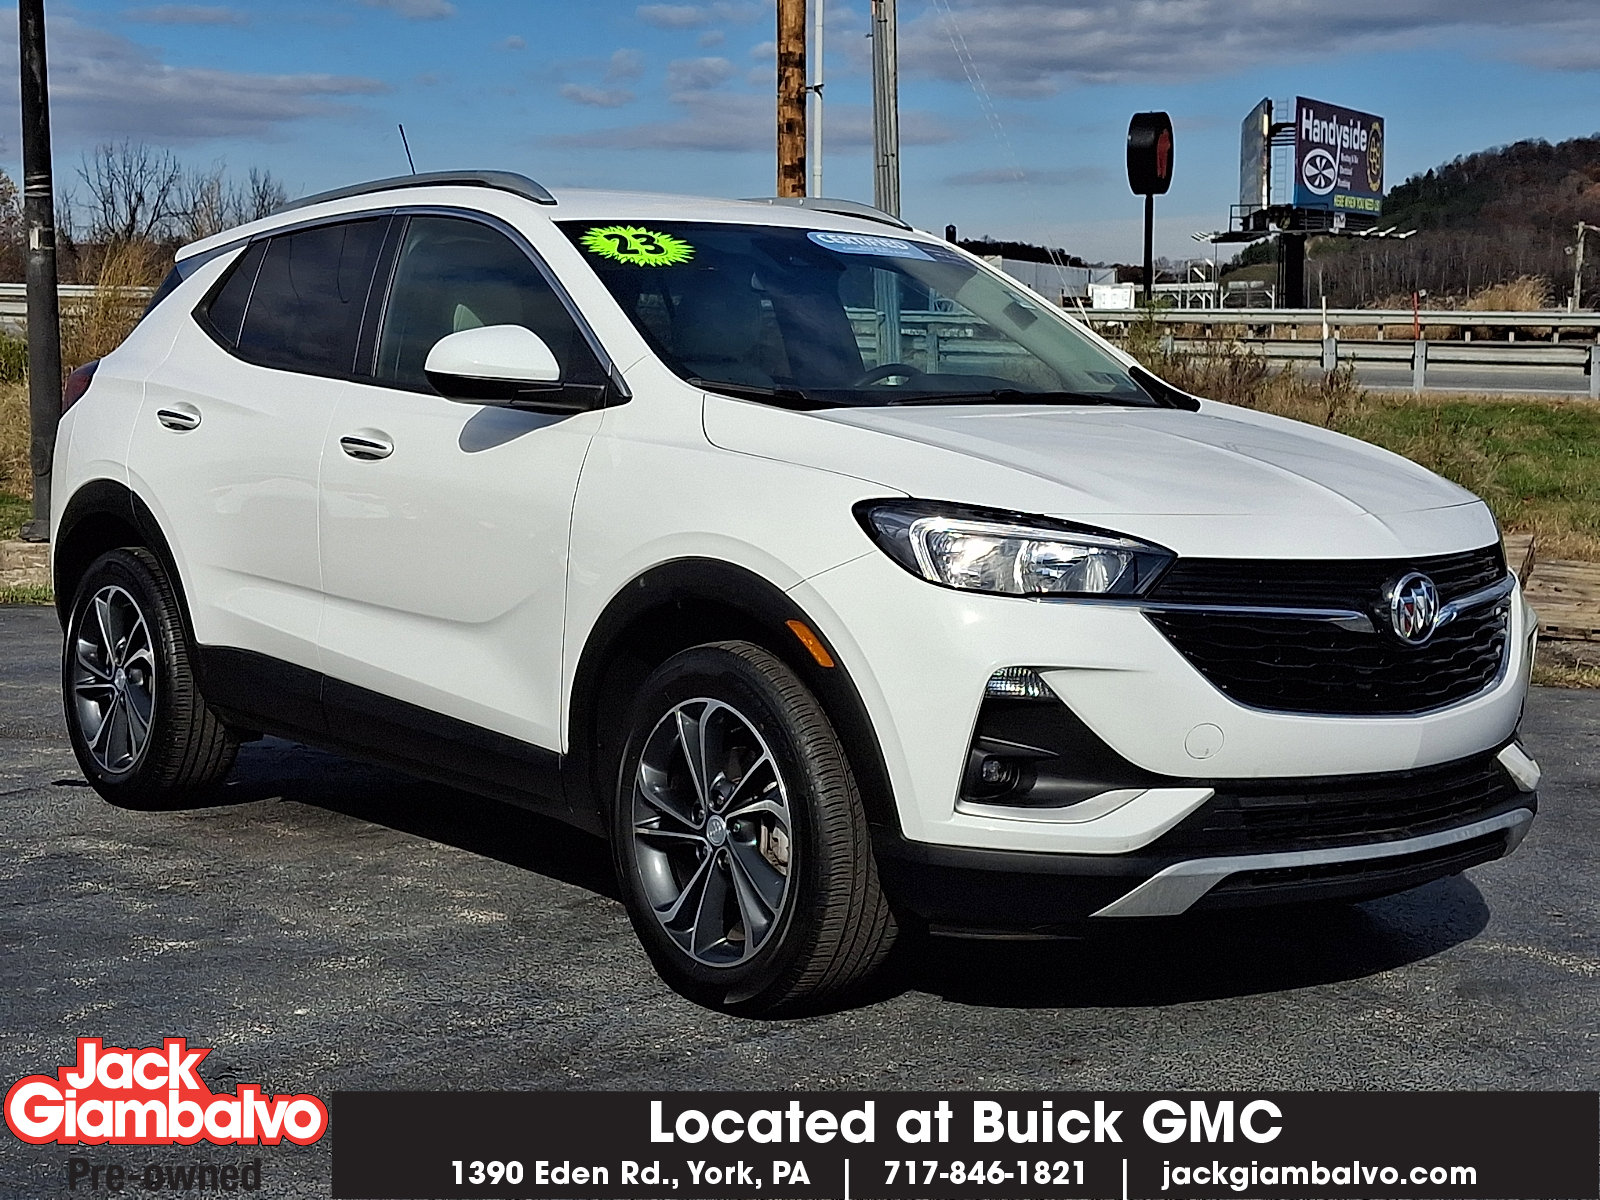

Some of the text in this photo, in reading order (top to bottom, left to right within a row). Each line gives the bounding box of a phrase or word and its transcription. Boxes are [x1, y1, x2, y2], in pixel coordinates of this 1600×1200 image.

[1301, 107, 1368, 152] Handyside
[603, 233, 665, 255] 23
[815, 233, 909, 250] CERTIFIED
